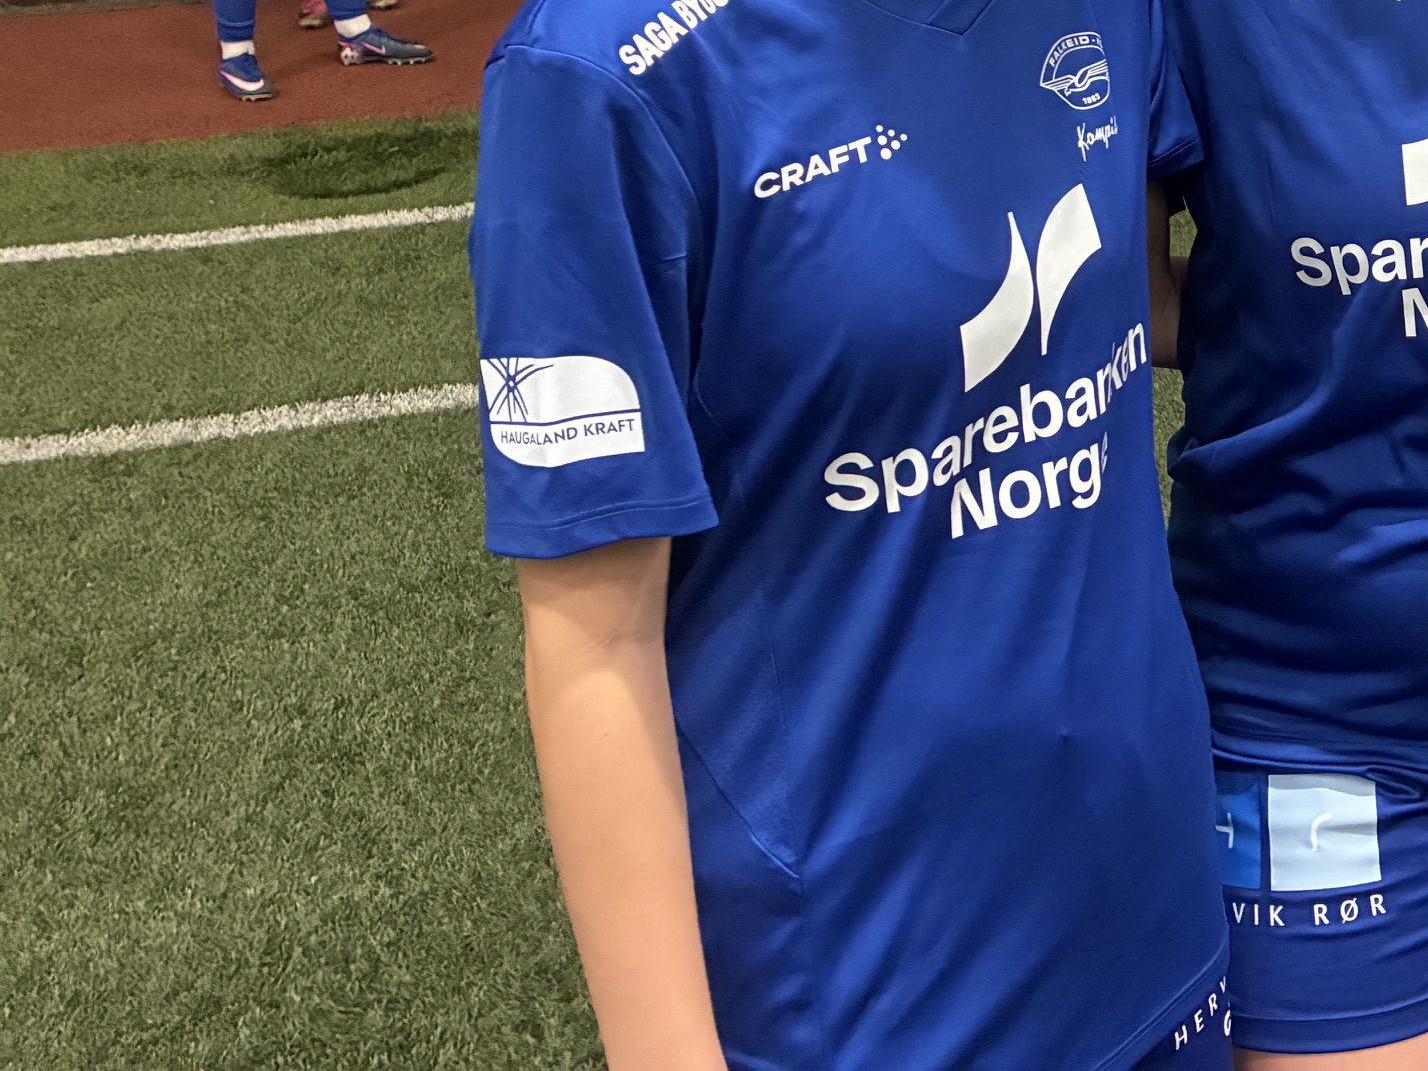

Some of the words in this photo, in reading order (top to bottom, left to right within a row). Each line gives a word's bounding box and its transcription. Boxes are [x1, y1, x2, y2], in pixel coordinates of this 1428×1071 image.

[618, 11, 689, 76] SAGA
[754, 136, 872, 199] CRAFT
[501, 427, 578, 446] HAUGALAND
[584, 419, 635, 437] KRAFT
[1313, 894, 1387, 926] RØR
[1174, 976, 1226, 1051] HERV
